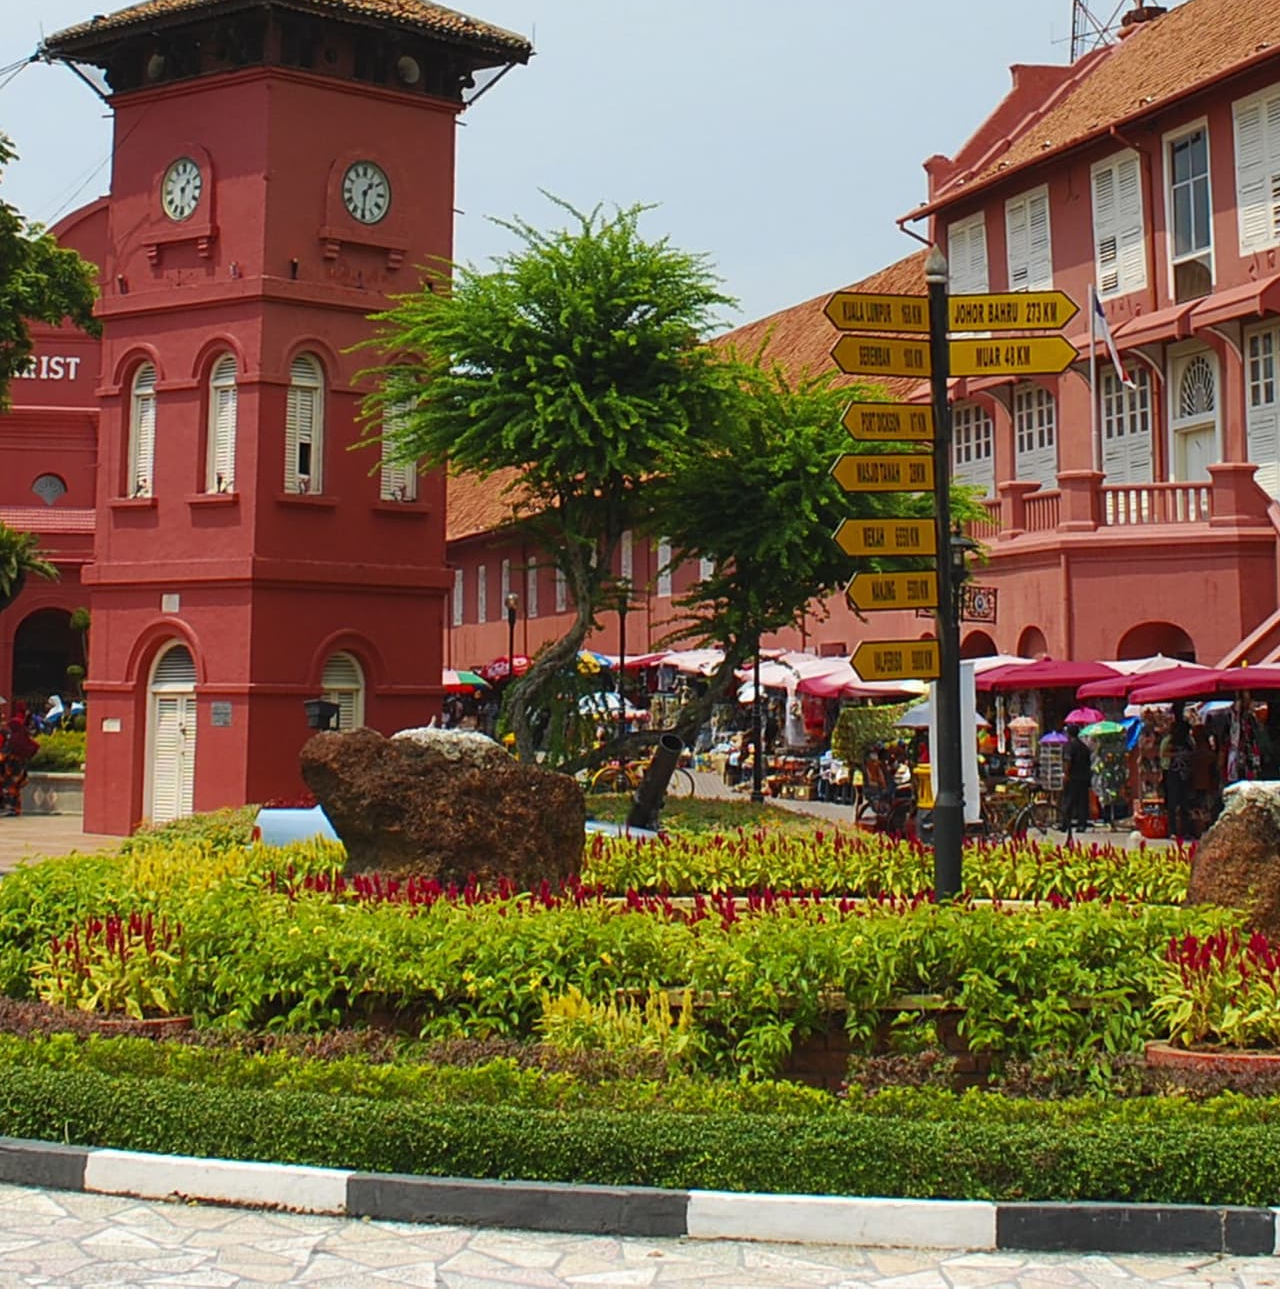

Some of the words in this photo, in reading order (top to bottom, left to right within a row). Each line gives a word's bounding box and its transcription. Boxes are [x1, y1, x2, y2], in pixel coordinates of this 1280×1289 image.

[954, 303, 984, 324] JOHOR
[988, 302, 1018, 323] BAHRU
[1026, 302, 1041, 323] 273
[1043, 302, 1057, 322] KM
[976, 346, 1000, 367] MUAR
[1017, 345, 1030, 366] KM
